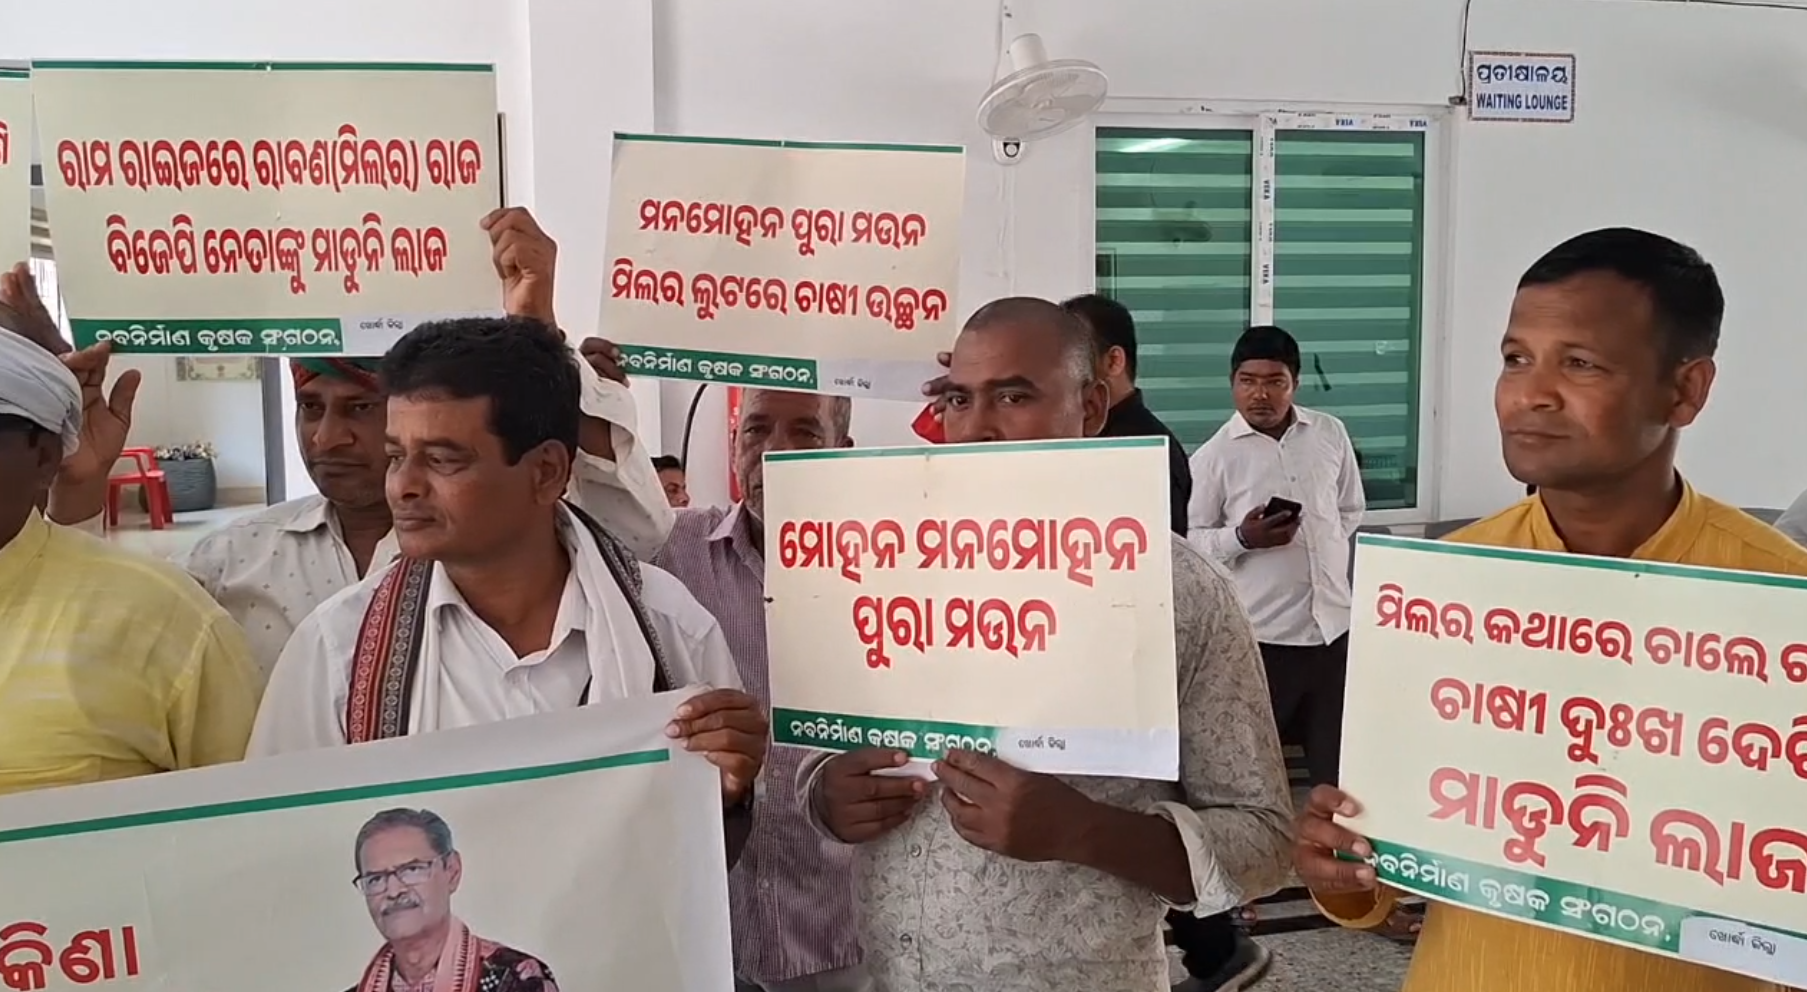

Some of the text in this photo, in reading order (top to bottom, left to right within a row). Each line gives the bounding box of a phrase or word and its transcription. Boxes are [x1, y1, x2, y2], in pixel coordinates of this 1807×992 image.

[1476, 64, 1568, 84] ପ୍ରତୀକ୍ଷାଳୟ
[1476, 93, 1568, 111] WAITING LOUNGE
[59, 140, 115, 190] ରାମ
[119, 140, 252, 191] ରାଇଜରେ
[253, 124, 422, 192] ରାବଣ(ମିଲର)
[426, 139, 483, 189] ରାଜ
[107, 213, 199, 276] ବିଜେପି
[204, 227, 308, 295] ନେତାଙ୍କୁ
[391, 227, 449, 277] ଲାଜ
[639, 199, 929, 257] ମନମୋହନ ପୁରା ମଉନ
[612, 257, 687, 308] ମିଲର
[690, 273, 790, 321] ଲୁଟରେ
[794, 280, 862, 315] ଚାଷୀ
[198, 328, 254, 351] କୃଷକ
[697, 359, 743, 380] କୃଷକ
[778, 516, 1148, 588] ମୋହନ ମନମୋହନ
[852, 594, 1057, 670] ପୁରା ମଉନ
[1376, 583, 1474, 643] ମିଲର
[1484, 607, 1633, 664] କଥାରେ
[1645, 627, 1769, 683] ଚାଲେ
[790, 717, 863, 744] ନବନିର୍ମାଣ
[1431, 677, 1549, 735] ଚାଷୀ
[1561, 695, 1684, 765] ଦୁଃଖ
[1479, 878, 1550, 911] କୃଷକ
